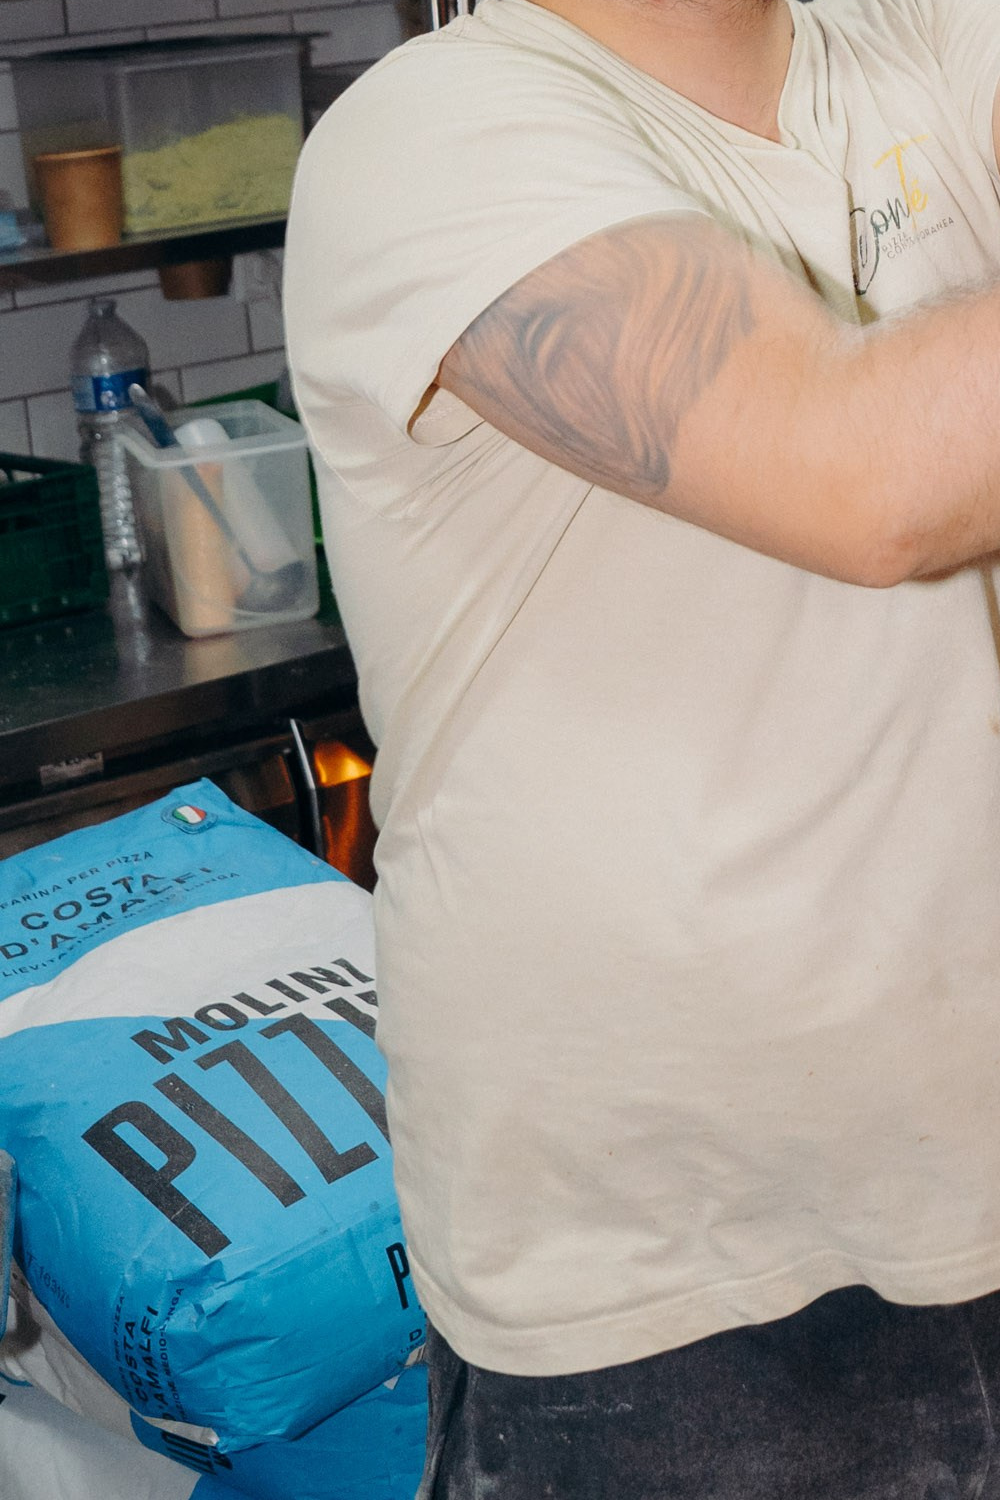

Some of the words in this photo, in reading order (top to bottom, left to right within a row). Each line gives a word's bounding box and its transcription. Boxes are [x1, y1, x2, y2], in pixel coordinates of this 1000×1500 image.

[20, 874, 165, 931] COSTA
[66, 867, 101, 885] PER
[106, 851, 154, 869] PIZZA
[130, 957, 375, 1065] MOLINI
[123, 1320, 149, 1403] COSTA
